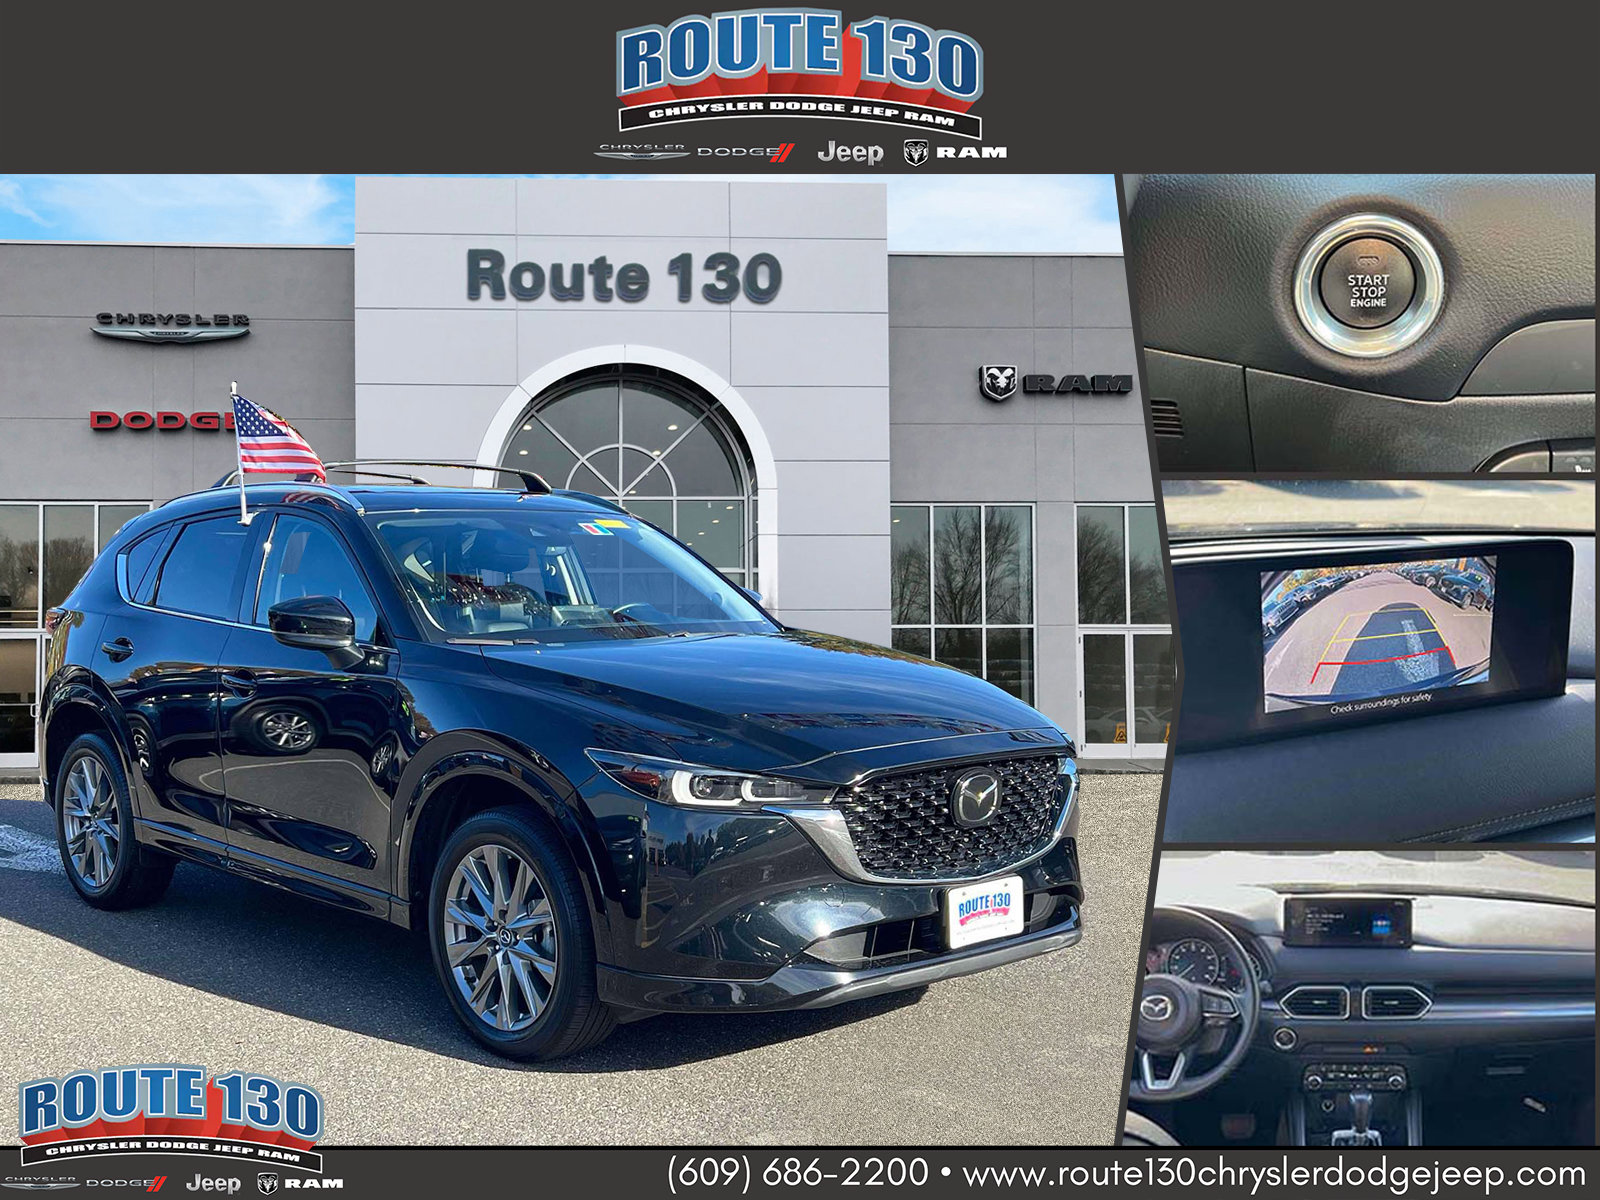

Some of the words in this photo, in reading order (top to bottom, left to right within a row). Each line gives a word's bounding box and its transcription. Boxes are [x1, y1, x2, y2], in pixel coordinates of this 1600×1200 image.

[467, 248, 649, 302] Route
[668, 252, 782, 304] 130
[1348, 274, 1390, 286] START
[1352, 286, 1387, 298] STOP
[1350, 298, 1386, 307] ENGINE
[96, 312, 250, 326] CHRYSLER
[1023, 374, 1133, 394] RAM
[1330, 703, 1353, 714] Check
[1354, 697, 1400, 711] surroundings
[1401, 694, 1411, 704] for
[1412, 692, 1432, 702] safety
[958, 894, 990, 917] ROUTE
[992, 892, 1011, 908] 130
